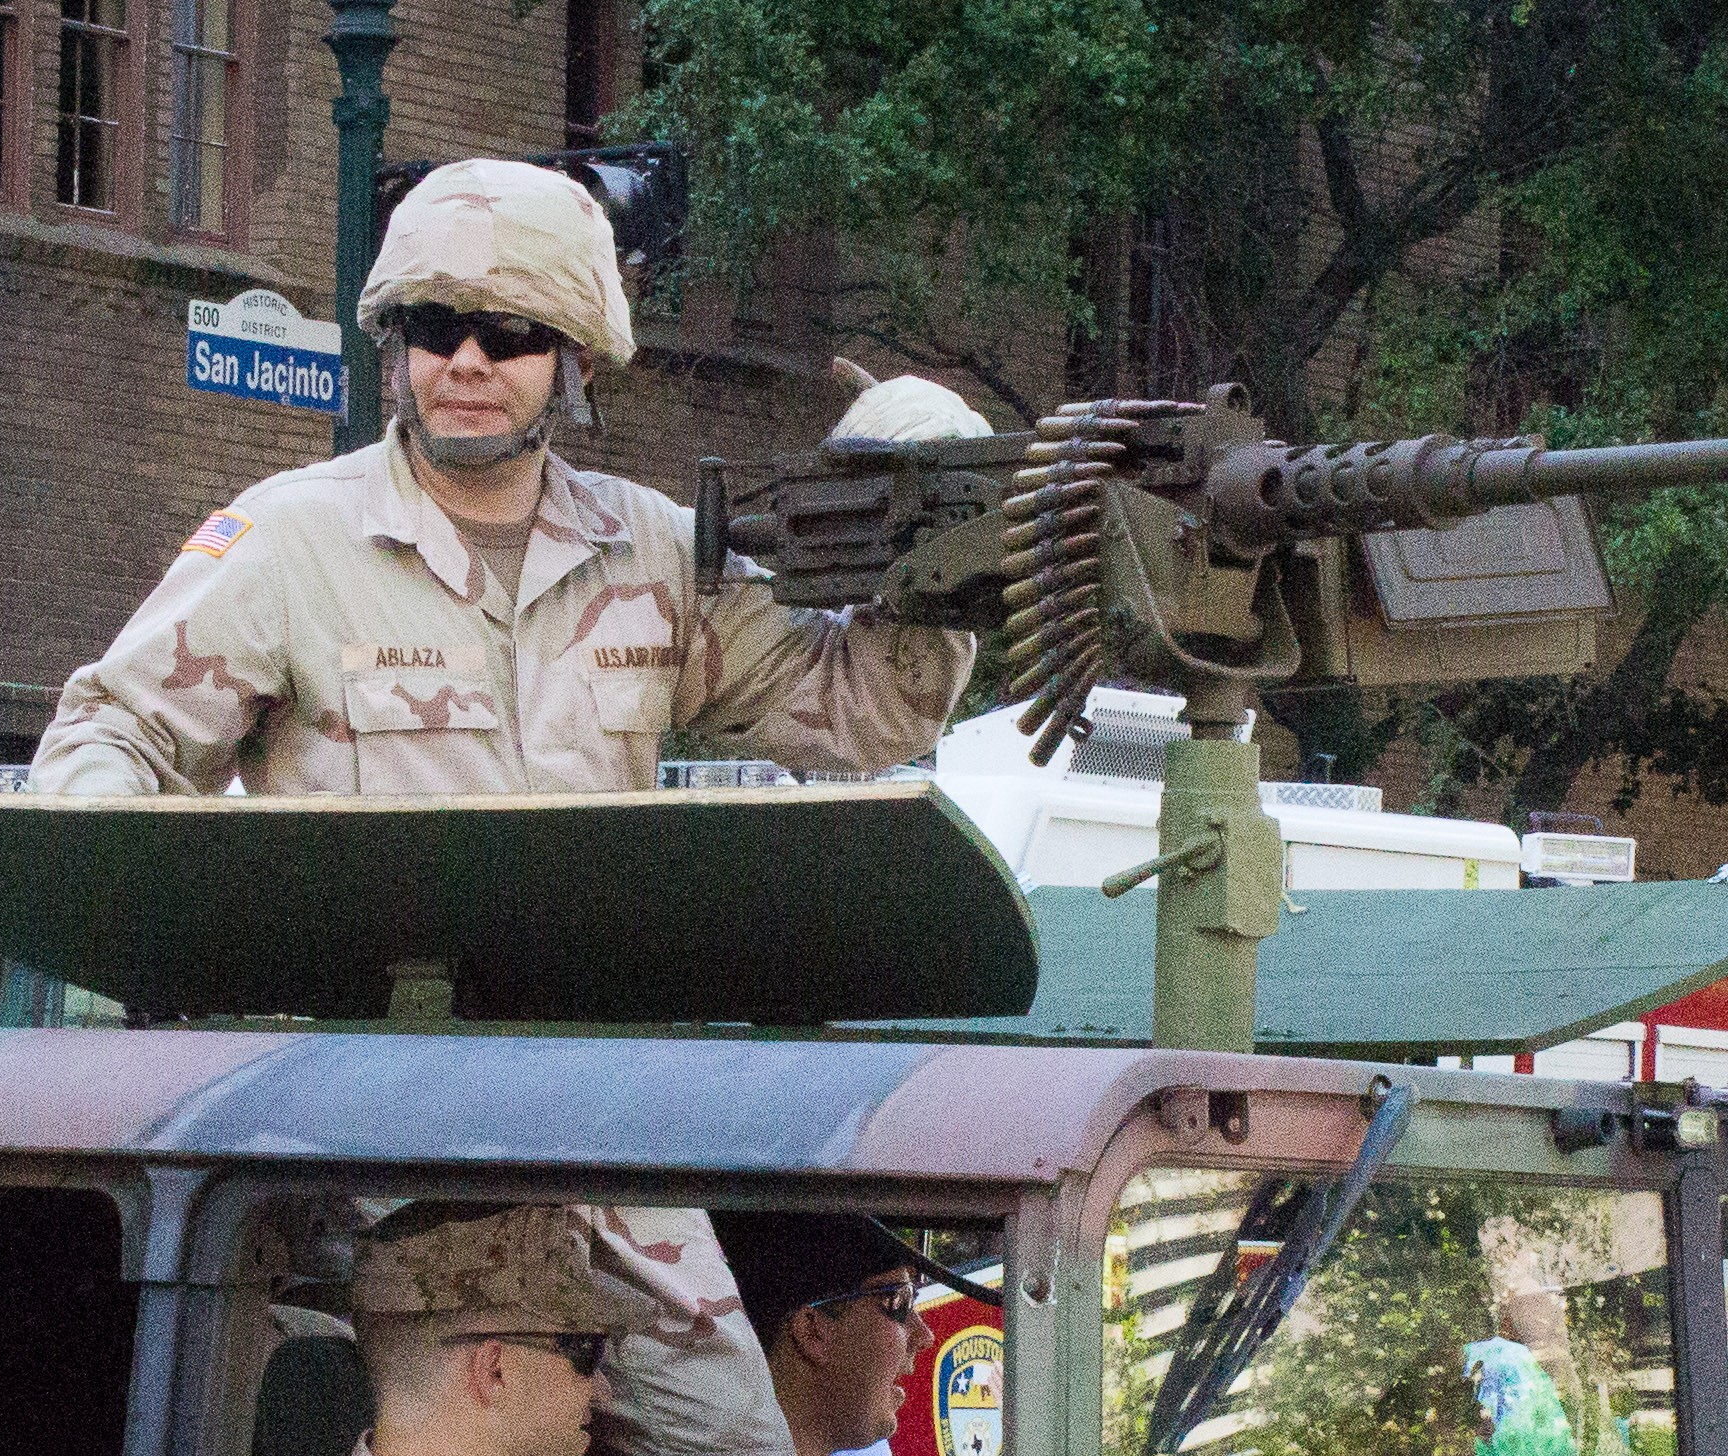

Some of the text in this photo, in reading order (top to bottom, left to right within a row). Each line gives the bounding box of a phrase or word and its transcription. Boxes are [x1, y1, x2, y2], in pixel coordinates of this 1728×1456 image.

[193, 305, 220, 328] 500
[242, 294, 288, 317] HISTORIC
[241, 319, 288, 340] DISTRICT
[195, 340, 334, 401] San Jacinto
[375, 646, 447, 670] ABLAZA
